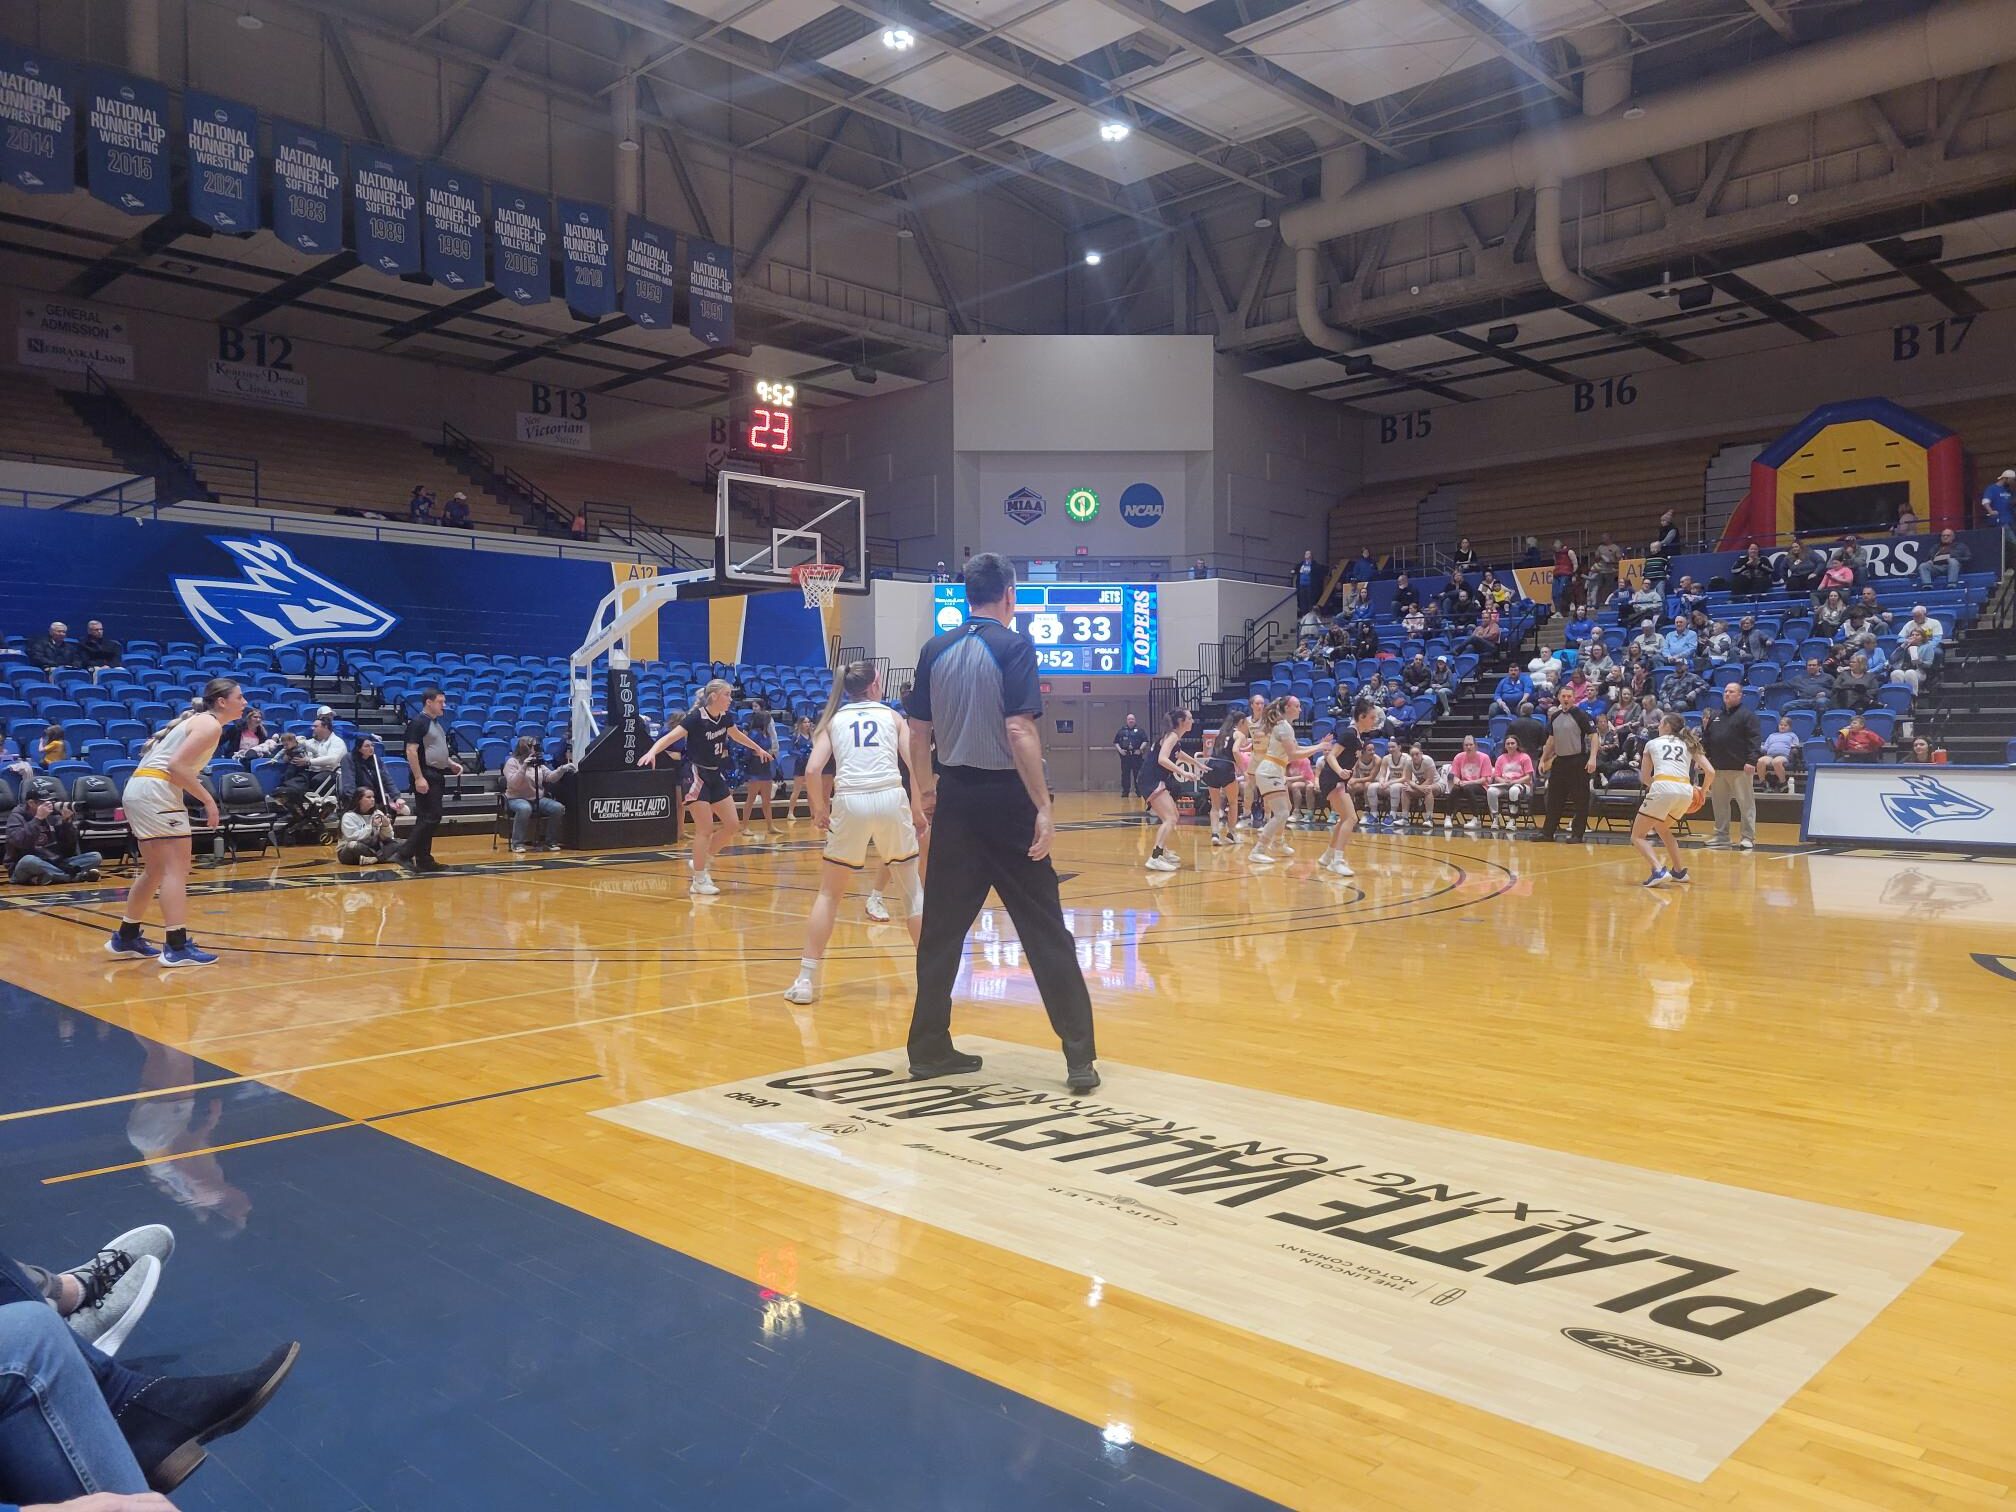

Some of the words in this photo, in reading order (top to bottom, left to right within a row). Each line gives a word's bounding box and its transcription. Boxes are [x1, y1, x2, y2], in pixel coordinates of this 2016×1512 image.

[0, 71, 64, 105] NATIONAL
[0, 87, 71, 121] UNNER-UP
[96, 96, 160, 127] NATIONAL
[90, 111, 166, 143] RUNNER-UP
[193, 118, 250, 148] NATIONAL
[100, 128, 158, 155] WRESTLING
[188, 133, 236, 160] RUNNER
[238, 146, 255, 164] UP
[107, 149, 154, 181] 2015
[195, 150, 248, 175] WRESTLING
[280, 144, 335, 175] NATIONAL
[203, 170, 242, 200] 2021
[275, 158, 340, 191] RUNNER-UP
[359, 169, 410, 196] NATIONAL
[285, 177, 329, 200] SOFTBALL
[355, 183, 415, 211] RUNNER-UP
[430, 187, 477, 215] NATIONAL
[289, 194, 327, 224] 1983
[365, 200, 407, 221] SOFTBALL
[426, 200, 482, 229] RUNNER-UP
[498, 207, 543, 232] NATIONAL
[370, 217, 405, 244] 1989
[435, 217, 473, 238] SOFTBALL
[494, 219, 547, 245] RUNNER-UP
[565, 222, 606, 243] NATIONAL
[438, 233, 471, 260] 1999
[500, 233, 542, 255] VOLLEYBALL
[563, 235, 596, 254] RUNNER
[597, 242, 609, 257] UP
[631, 237, 669, 264] NATIONAL
[504, 250, 538, 276] 2005
[568, 249, 607, 267] VOLLEYBALL
[627, 249, 673, 276] RUNNER-UP
[693, 260, 729, 281] NATIONAL
[690, 272, 732, 294] RUNNER-UP
[46, 303, 103, 324] GENERAL
[40, 318, 110, 339] ADMISSION
[756, 381, 795, 407] 9:52
[526, 421, 584, 438] Victorian
[751, 408, 790, 450] 23
[1124, 504, 1164, 517] NCAA
[1099, 590, 1122, 604] JETS
[1041, 624, 1052, 639] 3
[1072, 616, 1112, 642] 33
[1133, 590, 1150, 669] LOPERS
[1100, 655, 1113, 671] 0
[619, 673, 637, 764] LOPERS
[849, 720, 880, 748] 12
[714, 742, 724, 755] 21
[1662, 744, 1684, 763] 22
[593, 800, 621, 814] PLATTE
[621, 799, 648, 812] VALLEY
[647, 797, 667, 811] AUTO
[634, 810, 662, 818] KEARNEY
[723, 1091, 782, 1108] Jeep
[765, 1066, 1036, 1120] AUTO
[960, 1081, 1199, 1138] KEARNEY
[935, 1112, 1330, 1208] VALLEY
[1215, 1140, 1652, 1244] LEXINGTON
[1048, 1186, 1179, 1226] CHRYSLER
[1265, 1186, 1840, 1341] PLATTE
[1274, 1242, 1355, 1268] COMPANY
[1298, 1257, 1372, 1281] LINCOLN
[1358, 1265, 1418, 1286] MOTOR
[1375, 1278, 1406, 1292] THE
[1585, 1333, 1694, 1370] Ford
